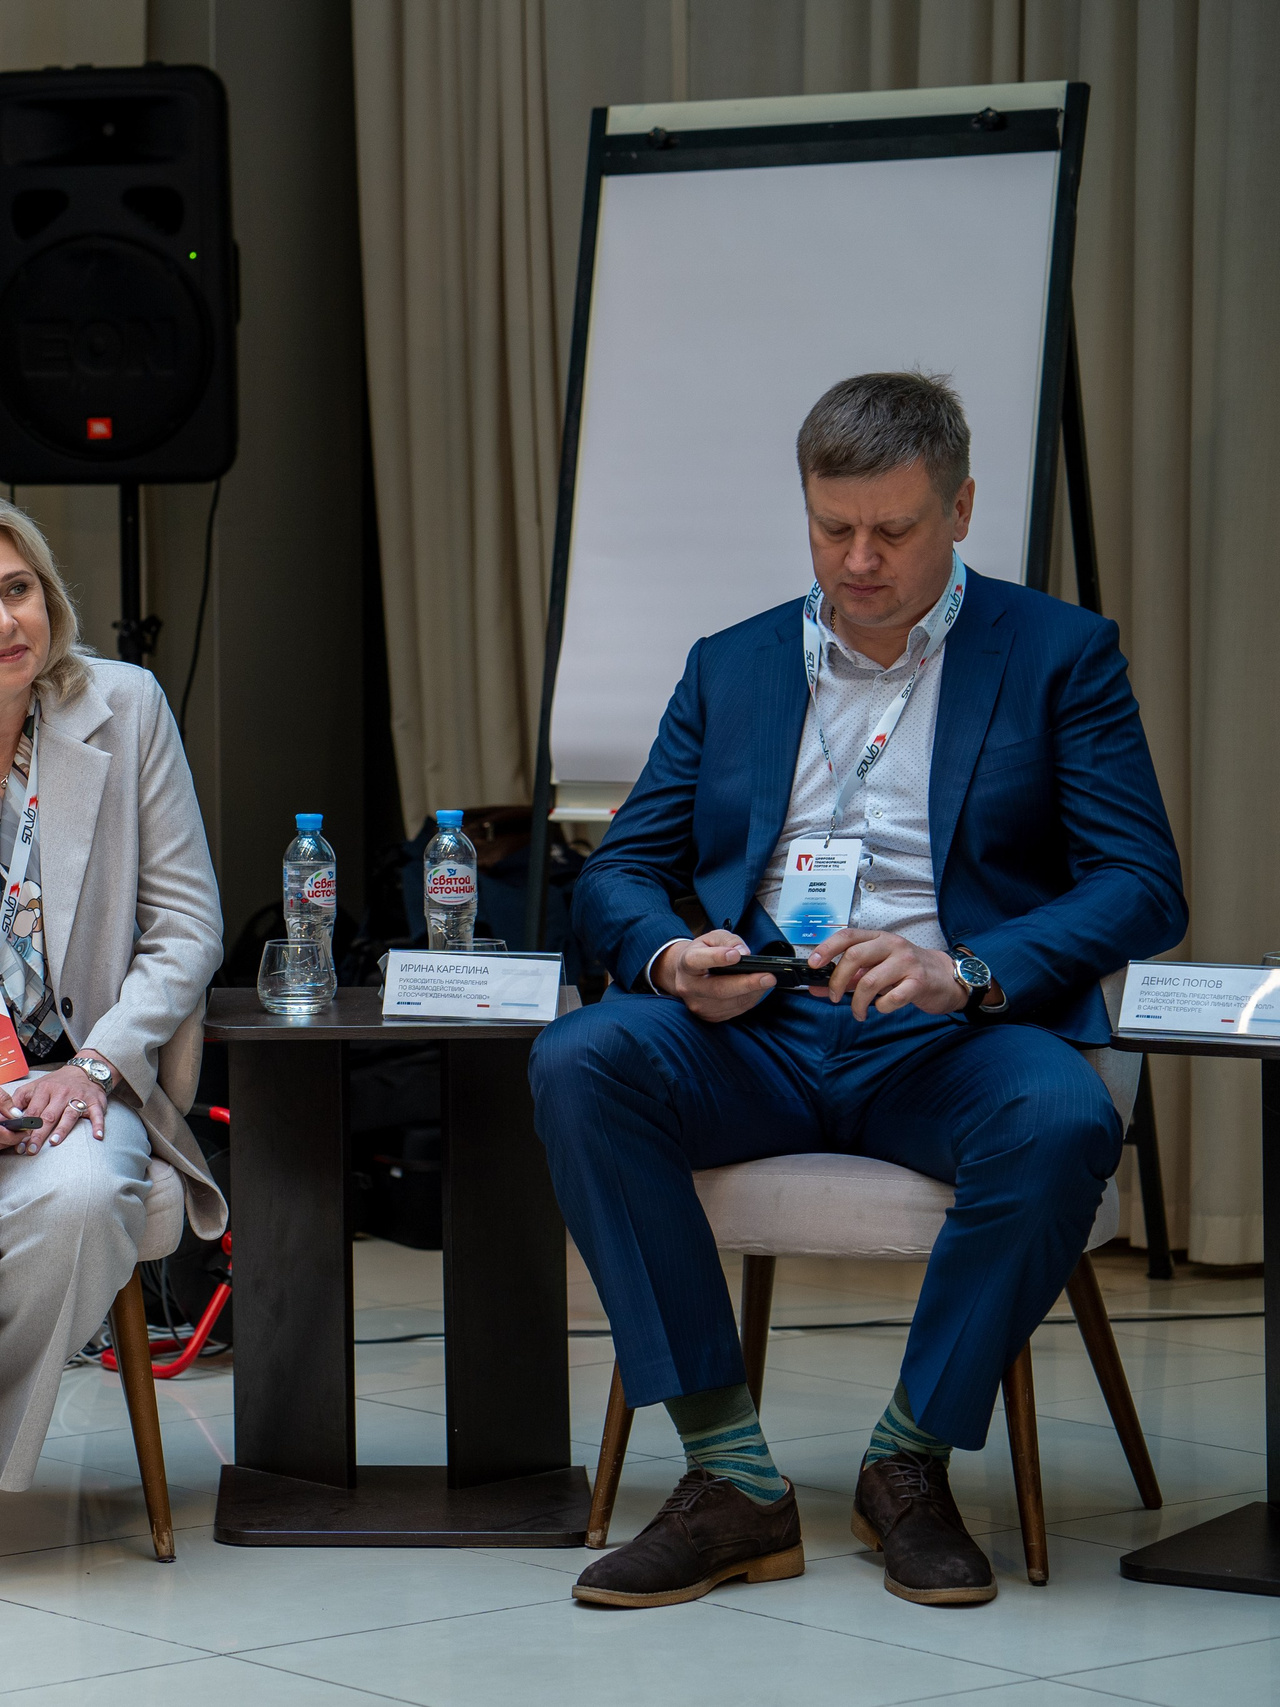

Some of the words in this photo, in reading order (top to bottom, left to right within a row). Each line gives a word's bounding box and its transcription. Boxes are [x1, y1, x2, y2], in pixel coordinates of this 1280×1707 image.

[400, 963, 434, 973] ИРИНА
[436, 964, 490, 975] КАРЕЛИНА
[1141, 976, 1180, 987] ДЕНИС
[1182, 978, 1223, 989] ПОПОВ
[1139, 990, 1188, 998] РУКОВОДИТЕЛЬ
[1138, 997, 1175, 1005] КИТАЙСКОЙ
[1142, 1005, 1202, 1014] САНКТ-ПЕТЕРБУРГЕ
